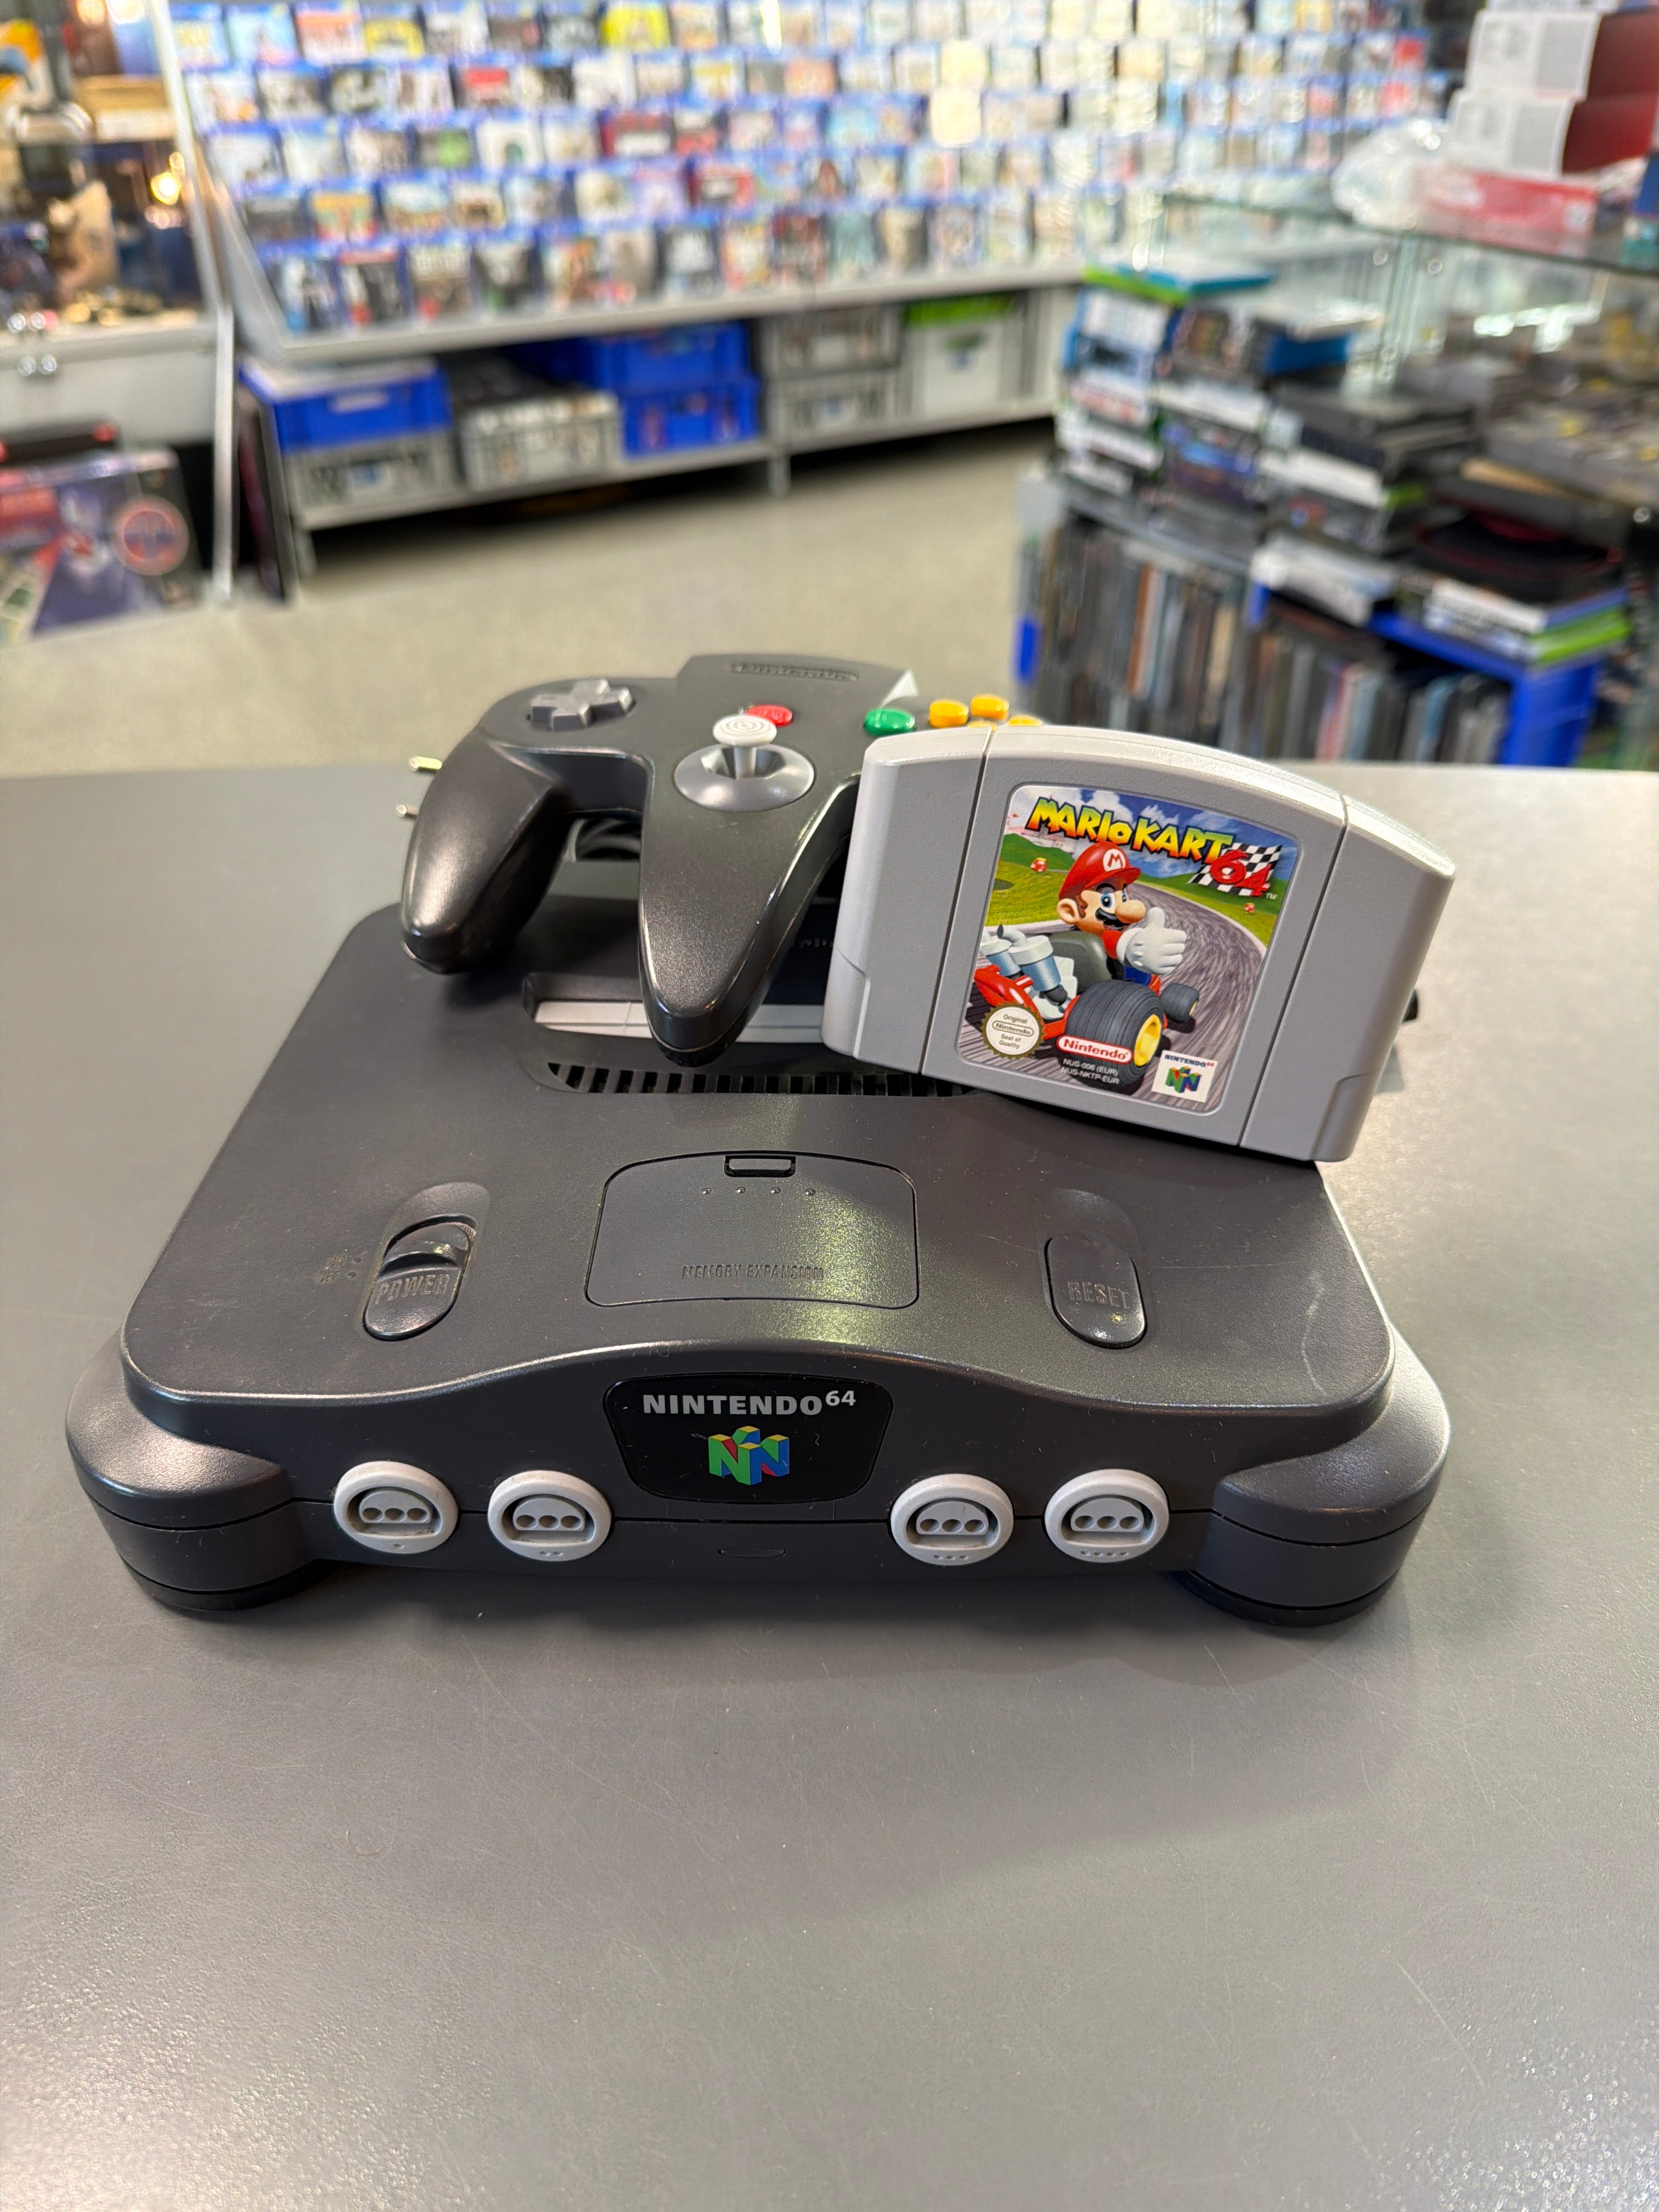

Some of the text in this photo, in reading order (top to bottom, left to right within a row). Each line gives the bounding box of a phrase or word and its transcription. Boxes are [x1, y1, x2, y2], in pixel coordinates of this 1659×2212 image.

[1107, 853, 1122, 867] M
[1210, 849, 1272, 897] 64
[1003, 1014, 1028, 1024] Original
[996, 1023, 1031, 1035] Nintendo
[999, 1040, 1020, 1049] Quality
[1063, 1058, 1119, 1076] NUS-006 (EUR)
[1164, 1054, 1206, 1068] NINTENDO
[1061, 1066, 1120, 1085] NUS-NKTP-EUR
[682, 1263, 823, 1280] MEMORY EXPANSION
[374, 1274, 450, 1305] POWER
[1067, 1281, 1128, 1310] RESET
[643, 1390, 856, 1415] NINTENDO 64
